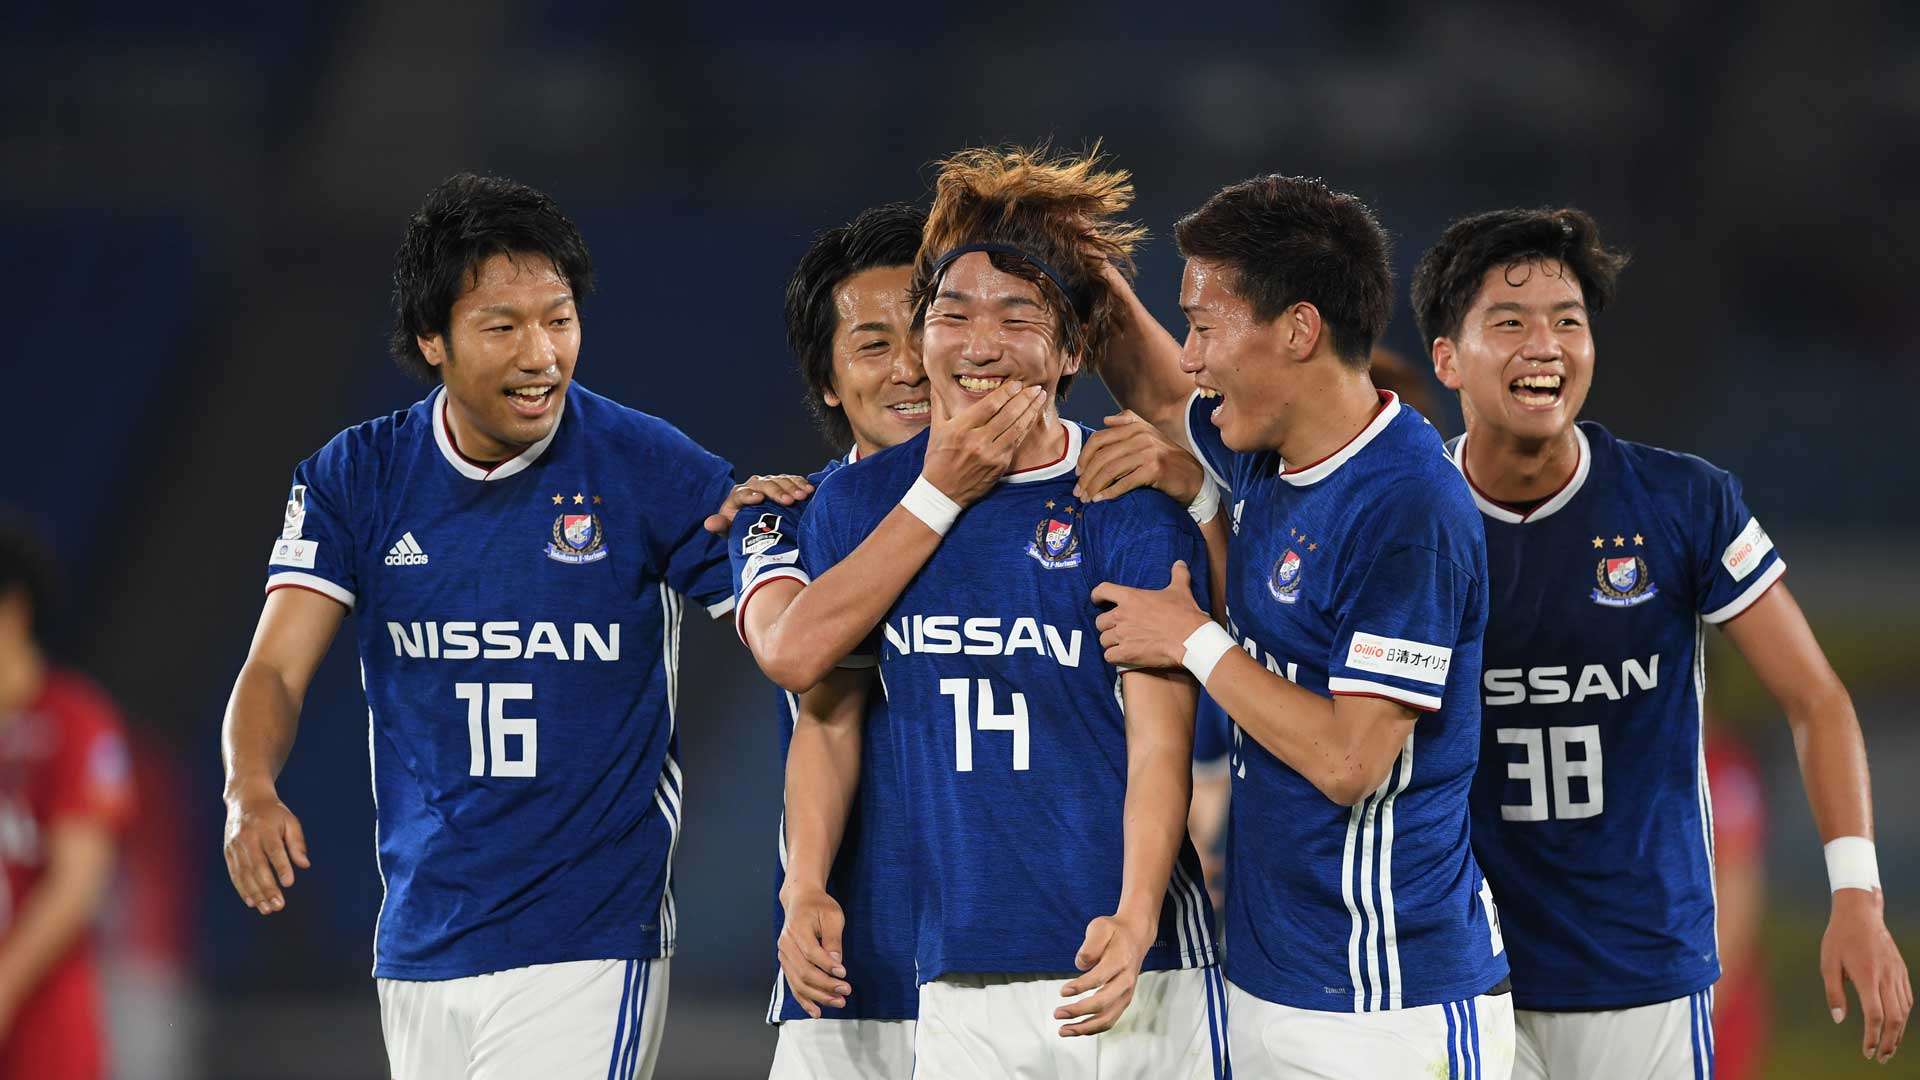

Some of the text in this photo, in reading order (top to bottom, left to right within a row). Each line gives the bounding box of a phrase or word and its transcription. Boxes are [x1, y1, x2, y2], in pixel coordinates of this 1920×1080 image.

[384, 552, 429, 566] adidas
[386, 621, 620, 661] NISSAN
[883, 614, 1082, 667] NISSAN
[1386, 648, 1448, 671] 日清オイリオ
[1484, 653, 1659, 706] SSAN
[455, 683, 537, 777] 16
[940, 678, 1030, 772] 14
[1496, 724, 1604, 822] 38
